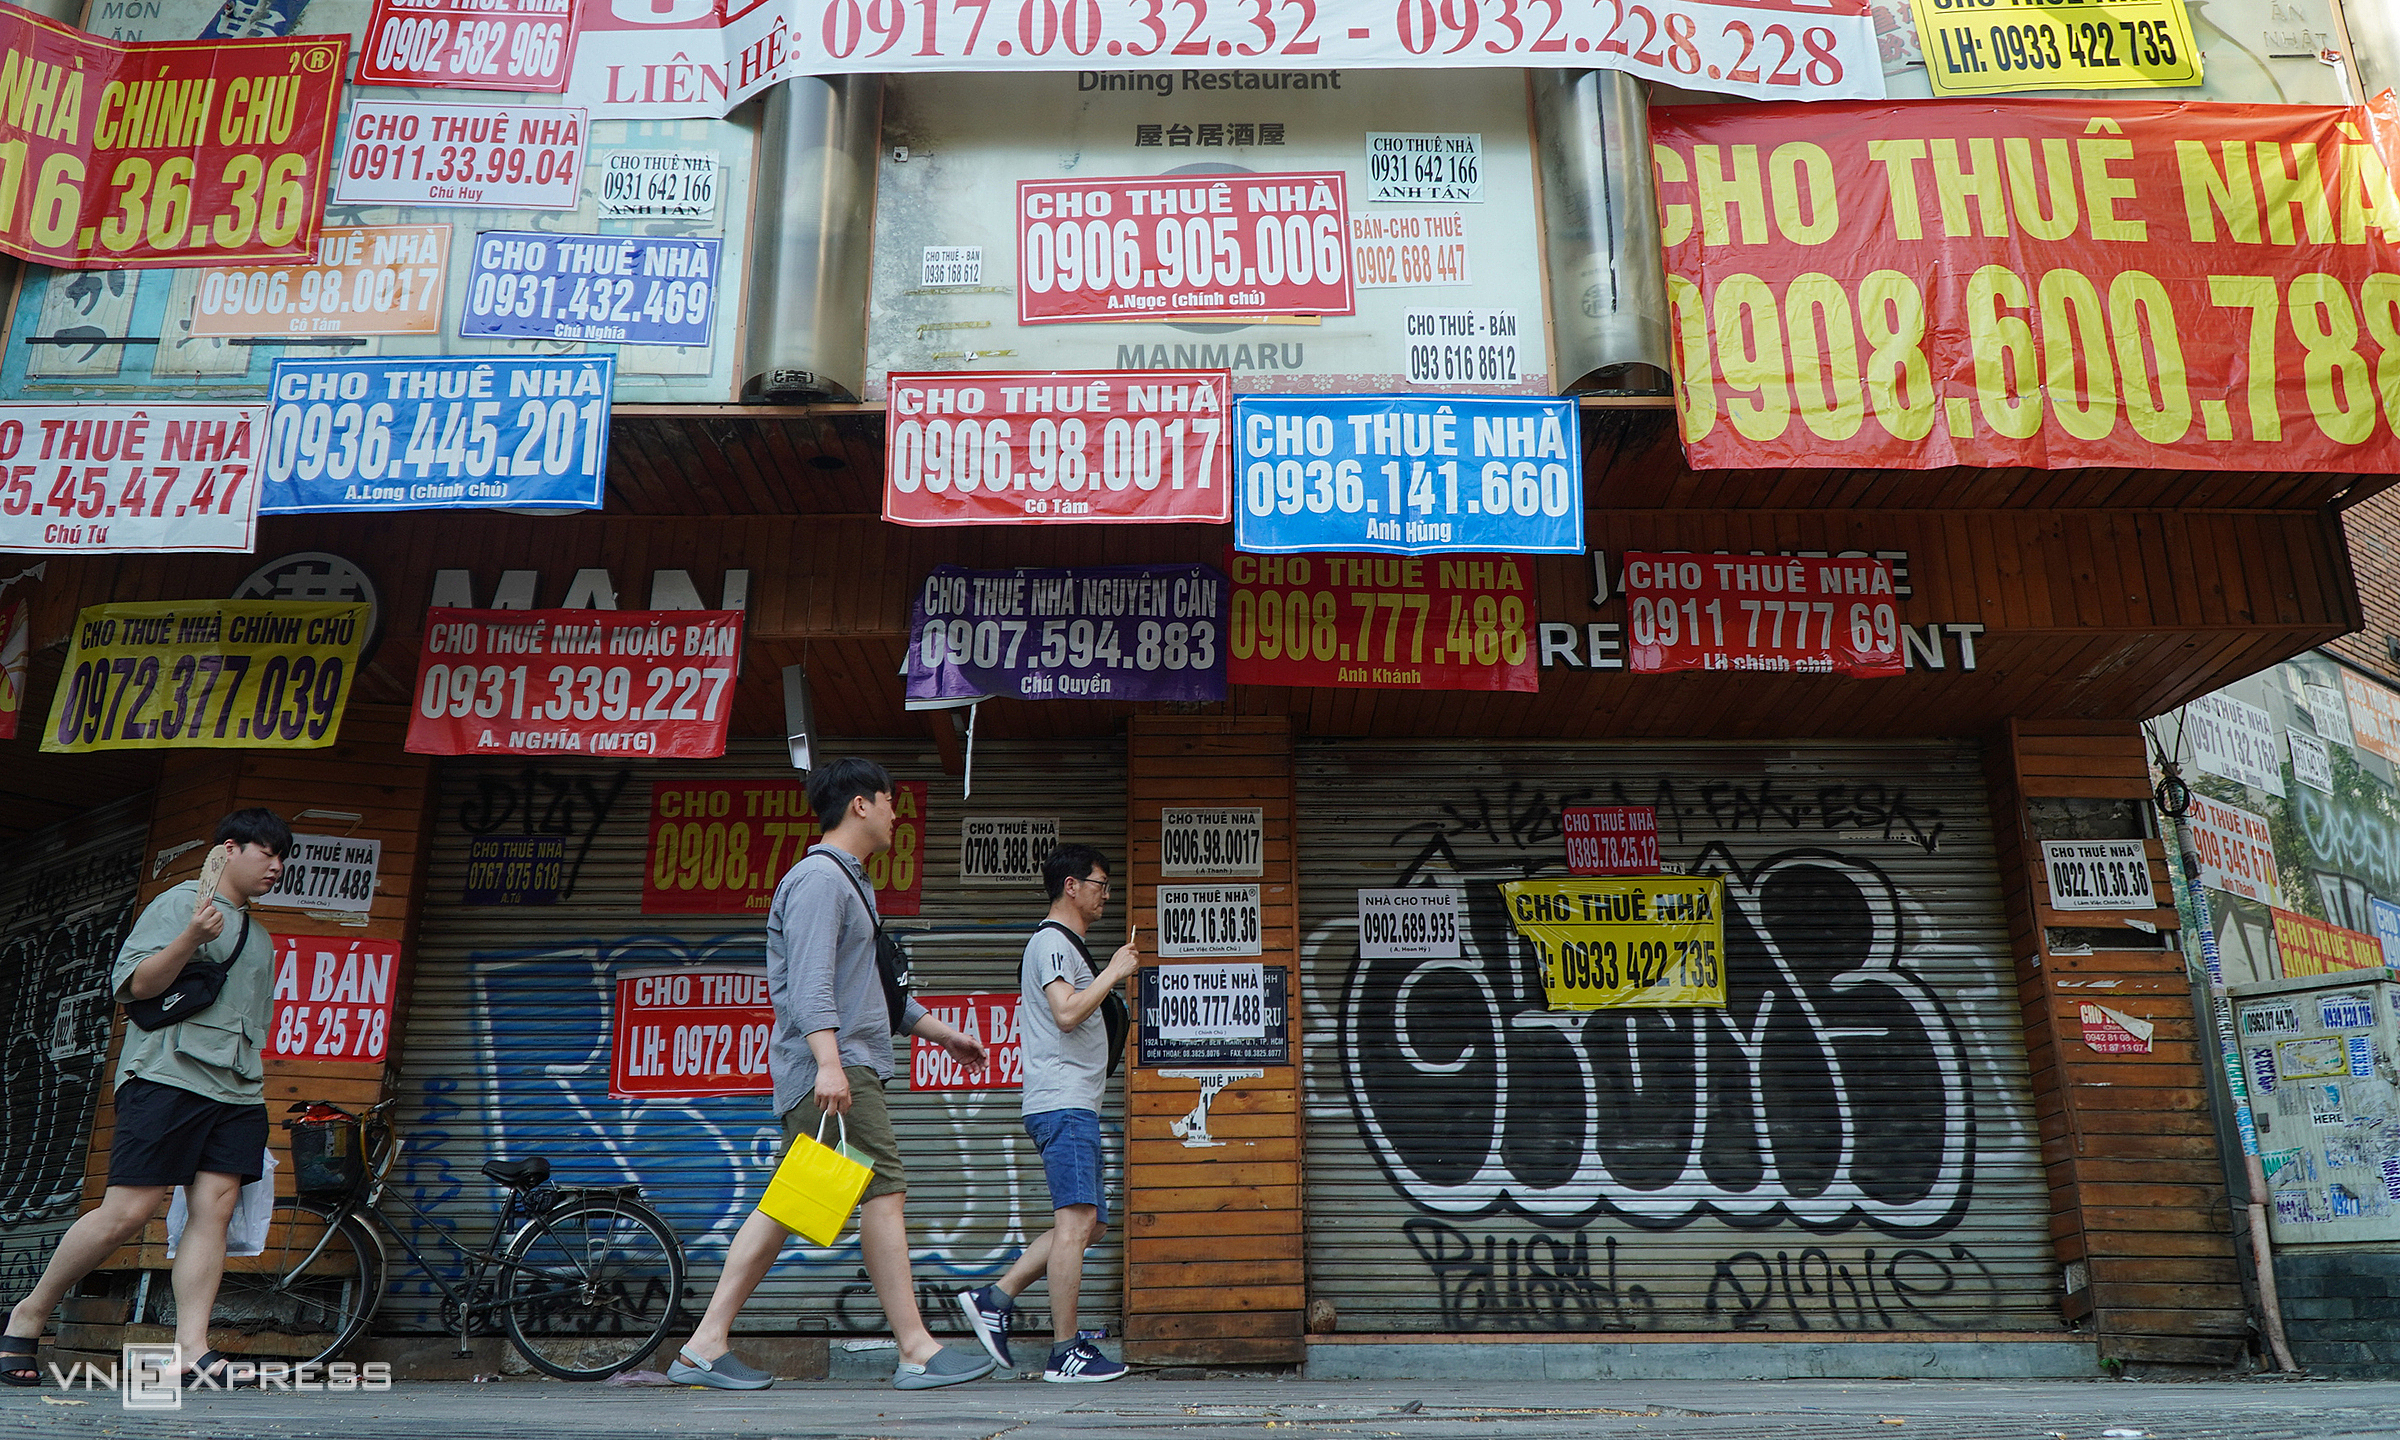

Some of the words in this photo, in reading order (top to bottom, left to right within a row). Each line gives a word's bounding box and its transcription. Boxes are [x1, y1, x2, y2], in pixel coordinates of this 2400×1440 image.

[376, 17, 445, 72] 0902
[449, 20, 507, 76] 582
[508, 22, 563, 77] 966
[602, 52, 731, 103] LIÊN
[821, 0, 1320, 59] 0917.00.32.32
[1396, 0, 1844, 87] 0932.228.228
[1939, 27, 1988, 74] LH:
[1990, 24, 2060, 72] 0933
[2068, 22, 2121, 68] 422
[2123, 20, 2177, 66] 735
[0, 48, 85, 146] NHÀ
[93, 66, 216, 150] CHÍNH
[219, 51, 301, 146] CHỦ
[1078, 70, 1173, 96] Dining
[1182, 69, 1341, 91] Restaurant
[1135, 123, 1285, 147] 屋台居酒屋
[1373, 138, 1404, 152] CHO
[1405, 135, 1443, 153] THUÊ
[1445, 136, 1475, 153] NHÀ
[348, 144, 573, 186] 0911.33.99.04
[610, 156, 640, 170] CHO
[644, 153, 681, 171] THUÊ
[683, 154, 711, 171] NHÀ
[1371, 154, 1408, 182] 0931
[1414, 155, 1443, 182] 642
[1449, 156, 1478, 184] 166
[429, 185, 454, 199] Chú
[458, 187, 483, 202] Huy
[604, 173, 642, 200] 0931
[648, 173, 677, 201] 642
[681, 174, 711, 201] 166
[1378, 187, 1422, 198] ANH
[1653, 141, 1840, 247] CHO
[1868, 116, 2148, 243] THUÊ
[2174, 121, 2400, 247] NHÀ
[1353, 213, 1420, 240] BÁN-CHO
[1424, 211, 1463, 237] THUÊ
[925, 251, 940, 261] CHO
[941, 249, 959, 261] THUÊ
[965, 248, 980, 261] BÁN
[1027, 214, 1341, 294] 0906.905.006
[1356, 246, 1397, 284] 0902
[1401, 244, 1432, 283] 688
[1437, 244, 1464, 281] 447
[201, 268, 439, 315] 0906.98.0017
[924, 264, 945, 284] 0936
[946, 264, 961, 284] 168
[963, 264, 979, 283] 612
[473, 272, 708, 325] 0931.432.469
[1108, 294, 1167, 311] A.Ngọc
[1172, 293, 1223, 309] (chính
[1228, 290, 1265, 307] chủ)
[554, 323, 581, 338] Chú
[585, 325, 625, 340] Nghĩa
[1407, 314, 1435, 336] CHO
[1440, 310, 1475, 336] THUÊ
[1490, 310, 1516, 336] BÁN
[1117, 343, 1303, 370] MANMARU
[1411, 344, 1439, 380] 093
[1444, 345, 1474, 380] 616
[1479, 345, 1516, 380] 8612
[267, 399, 600, 482] 0936.445.201
[894, 417, 1220, 494] 0906.98.0017
[345, 485, 404, 501] A.Long
[410, 483, 464, 502] (chính
[468, 480, 508, 498] chủ)
[1025, 498, 1048, 514] Cô
[1052, 498, 1088, 514] Tám
[1247, 459, 1569, 517] 0936.141.660
[44, 524, 82, 544] Chú
[87, 525, 109, 544] Tư
[1366, 517, 1400, 541] Anh
[1405, 519, 1452, 543] Hùng
[924, 575, 966, 616] CHO
[973, 570, 1025, 616] THUÊ
[1031, 570, 1075, 616] NHÀ
[1081, 572, 1168, 617] NGUYÊN
[1173, 567, 1217, 618] CĂN
[80, 618, 115, 650] CHO
[121, 613, 175, 646] THUÊ
[176, 610, 222, 644] NHÀ
[229, 611, 303, 645] CHÍNH
[306, 610, 356, 645] CHỦ
[429, 623, 478, 654] CHO
[485, 619, 546, 655] THUÊ
[550, 619, 602, 656] NHÀ
[609, 621, 677, 663] HOẶC
[683, 622, 736, 657] BÁN
[1230, 589, 1526, 666] 0908.777.488
[1632, 596, 1724, 647] 0911
[1740, 600, 1834, 650] 7777
[1850, 603, 1897, 654] 69
[920, 619, 1215, 671] 0907.594.883
[420, 664, 730, 721] 0931.339.227
[1020, 674, 1053, 694] Chú
[1058, 672, 1111, 696] Quyền
[1337, 667, 1368, 682] Anh
[1372, 667, 1421, 684] Khánh
[57, 655, 344, 745] 0972.377.039
[2212, 697, 2245, 726] THUÊ
[2246, 710, 2272, 737] NHÀ
[477, 729, 499, 747] A.
[509, 729, 581, 749] NGHĨA
[590, 732, 657, 754] (MTG)
[2190, 713, 2225, 758] 0971
[2227, 727, 2254, 767] 132
[2254, 736, 2280, 777] 168
[1168, 813, 1193, 824] CHO
[1196, 811, 1228, 824] THUÊ
[1231, 811, 1256, 824] NHÀ
[1564, 813, 1590, 833] CHO
[1592, 808, 1626, 832] THUÊ
[1629, 808, 1655, 831] NHÀ
[2210, 806, 2242, 835] THUÊ
[2243, 817, 2270, 845] NHÀ
[1164, 828, 1260, 865] 0906.98.0017
[1567, 836, 1659, 869] 0389.78.25.12
[2222, 835, 2251, 879] 545
[2251, 844, 2278, 888] 670
[468, 862, 504, 890] 0767
[505, 862, 532, 890] 875
[533, 862, 560, 890] 618
[2053, 861, 2149, 898] 0922.16.36.36
[1365, 894, 1391, 905] NHÀ
[1394, 896, 1418, 905] CHO
[1420, 894, 1451, 905] THUÊ
[1164, 906, 1257, 944] 0922.16.36.36
[1364, 912, 1455, 943] 0902.689.935
[2275, 917, 2309, 950] CHO
[2310, 927, 2351, 961] THUÊ
[309, 942, 392, 1005] BÁN
[1561, 940, 1619, 989] 0933
[1626, 940, 1671, 989] 422
[1674, 940, 1718, 988] 735
[1161, 994, 1260, 1027] 0908.777.488
[276, 1005, 309, 1057] 85
[314, 1007, 349, 1056] 25
[353, 1008, 385, 1057] 78
[628, 1025, 666, 1076] LH:
[672, 1024, 733, 1076] 0972
[2313, 1113, 2344, 1125] HERE
